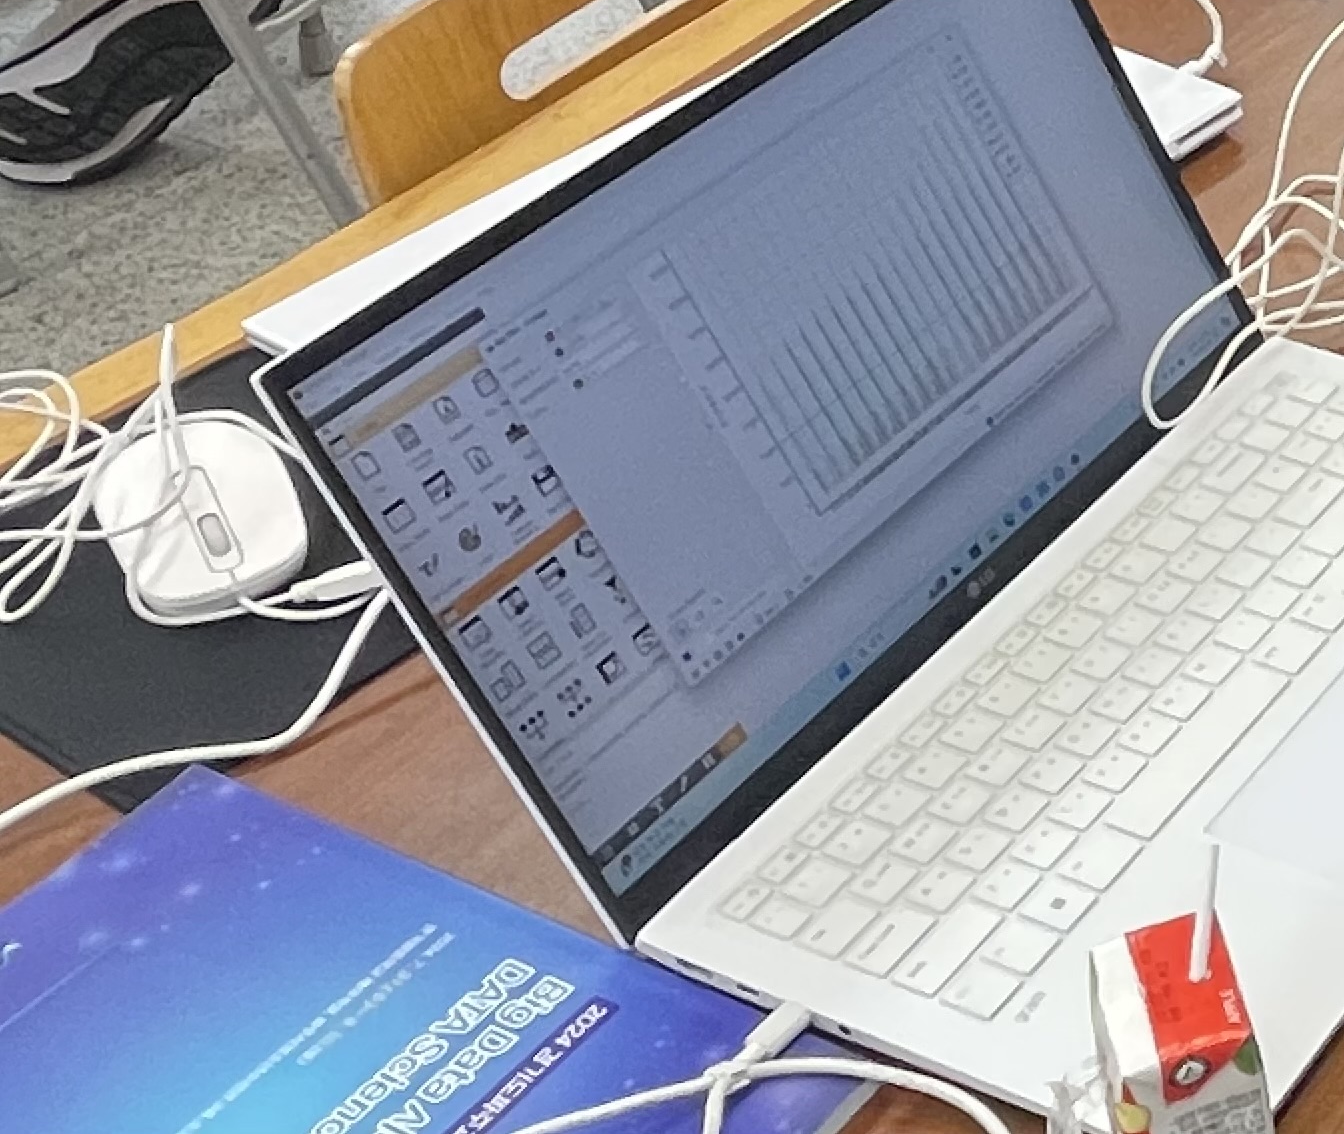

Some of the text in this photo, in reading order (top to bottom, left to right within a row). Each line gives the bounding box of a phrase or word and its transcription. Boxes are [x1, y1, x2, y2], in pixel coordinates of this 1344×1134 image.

[429, 958, 537, 1035] DATA
[495, 974, 576, 1030] Big
[555, 1004, 608, 1048] 2024
[416, 1024, 520, 1104] Data
